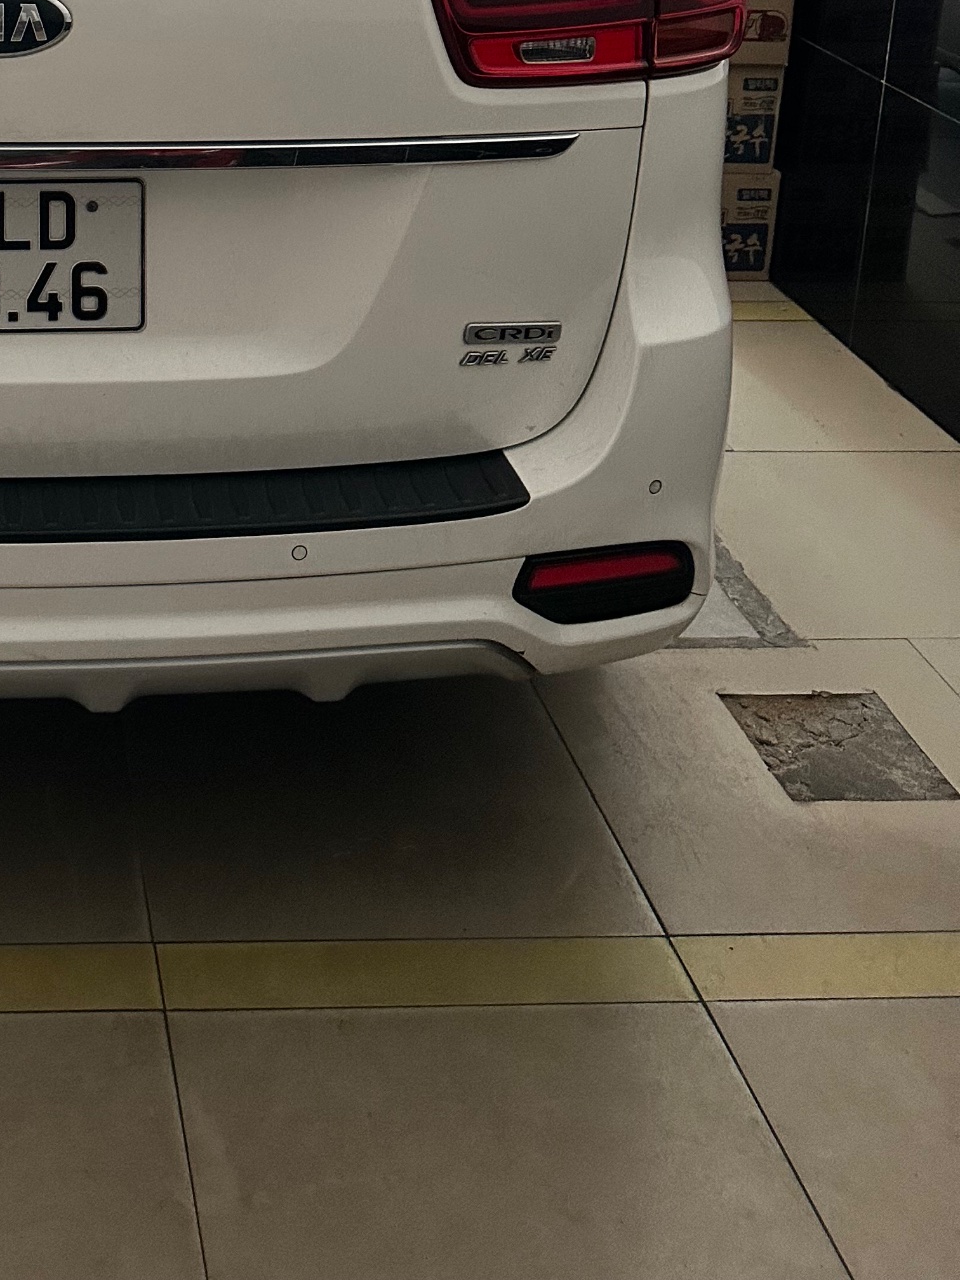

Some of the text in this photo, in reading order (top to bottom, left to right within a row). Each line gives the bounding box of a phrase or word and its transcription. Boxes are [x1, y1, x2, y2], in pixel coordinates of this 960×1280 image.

[725, 120, 769, 159] 국수
[722, 232, 763, 265] 국수
[474, 327, 554, 340] CRDi
[459, 349, 509, 367] DEL
